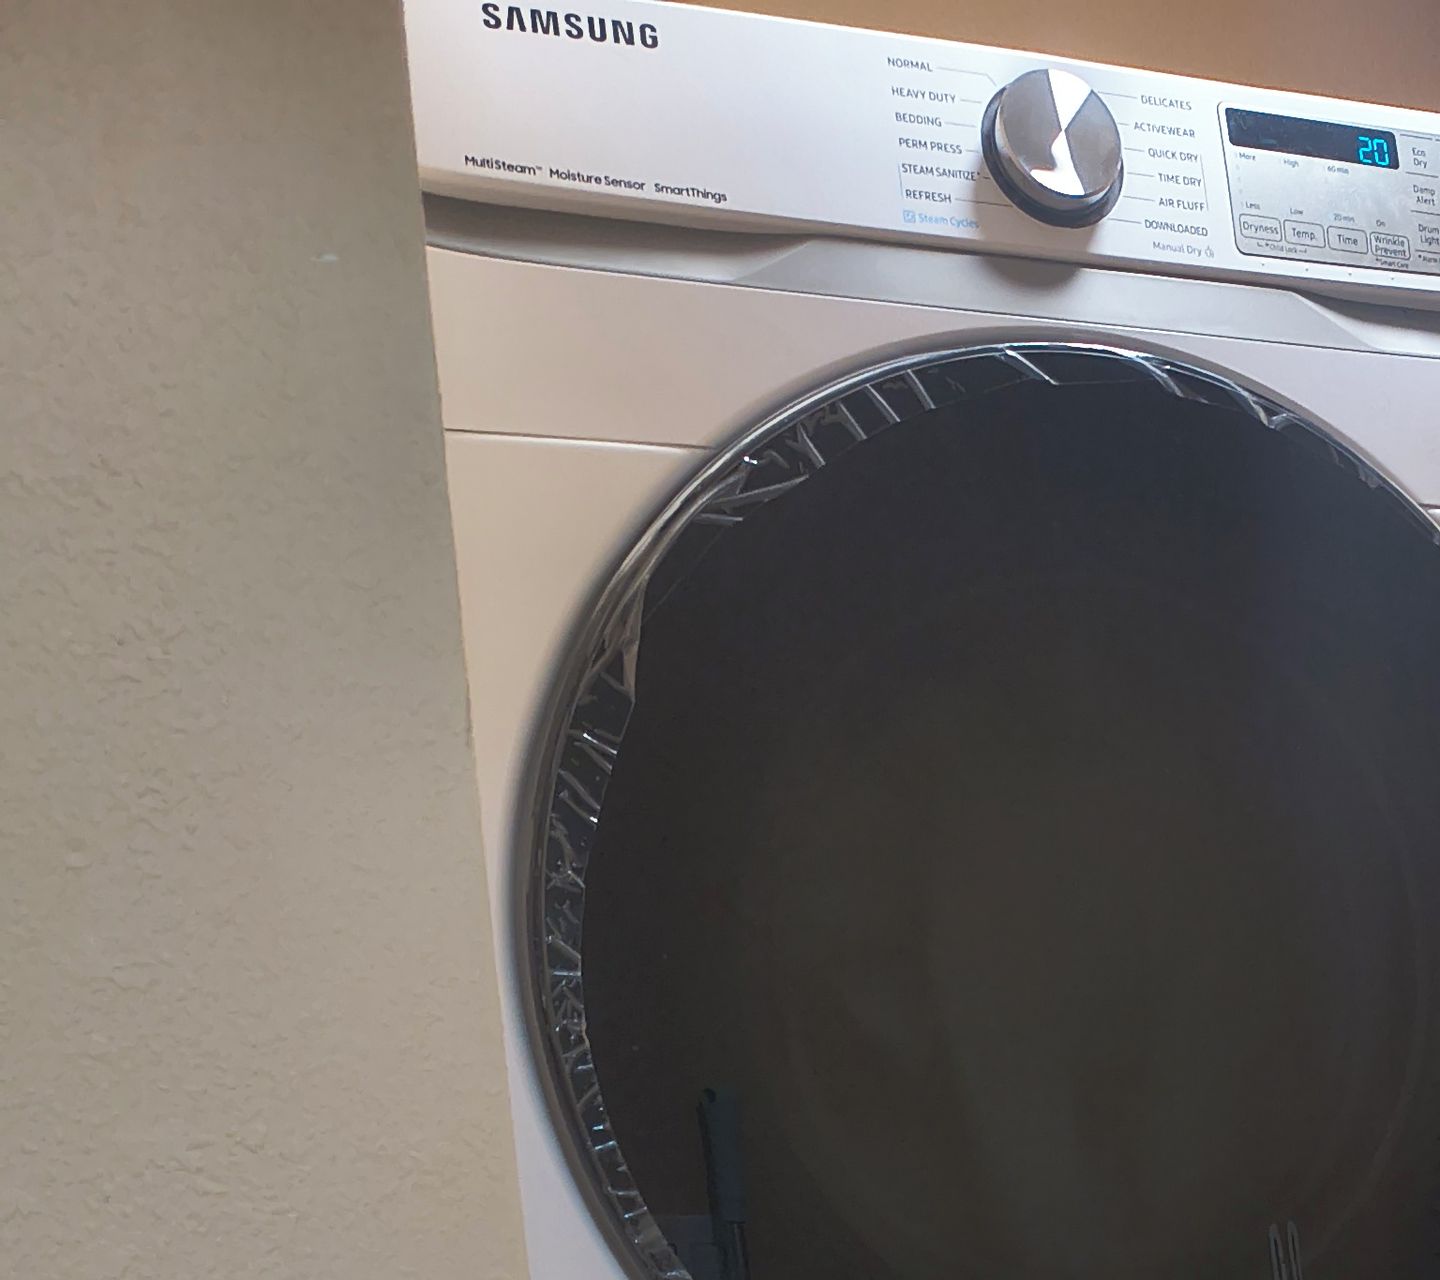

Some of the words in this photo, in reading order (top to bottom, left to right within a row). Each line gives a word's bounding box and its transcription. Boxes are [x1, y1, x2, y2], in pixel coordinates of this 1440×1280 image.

[481, 3, 659, 49] SAMSUNG
[887, 57, 933, 72] NORMAL
[891, 86, 926, 101] HEAVY
[928, 91, 956, 104] DUTY
[1141, 95, 1192, 111] DELICATES
[895, 112, 942, 127] BEDDING
[1133, 122, 1196, 138] ACTIVEWEAR
[898, 137, 928, 152] PERM
[929, 141, 963, 155] PRESS
[1357, 135, 1390, 167] 20
[1148, 149, 1178, 161] QUICK
[1179, 151, 1199, 163] DRY
[1413, 158, 1427, 169] Dry
[901, 163, 933, 178] STEAM
[549, 168, 602, 185] Moisture
[604, 174, 645, 192] Sensor
[654, 182, 727, 203] SmartThings
[1158, 173, 1181, 186] TIME
[1182, 175, 1202, 188] DRY
[905, 188, 951, 203] REFRESH
[1413, 185, 1436, 196] Damp
[1159, 198, 1175, 210] AIR
[1176, 199, 1205, 212] FLUFF
[1416, 196, 1436, 206] Alert
[918, 212, 948, 226] Steam
[1144, 219, 1208, 237] DOWNLOADED
[1242, 221, 1279, 236] Dryness
[1418, 224, 1439, 235] Drum
[1337, 233, 1358, 246] Time
[1373, 235, 1405, 248] Wrinkle
[1420, 234, 1440, 246] Light
[1153, 241, 1185, 255] Manual
[1186, 245, 1202, 258] Dry
[1374, 245, 1407, 258] Prevent
